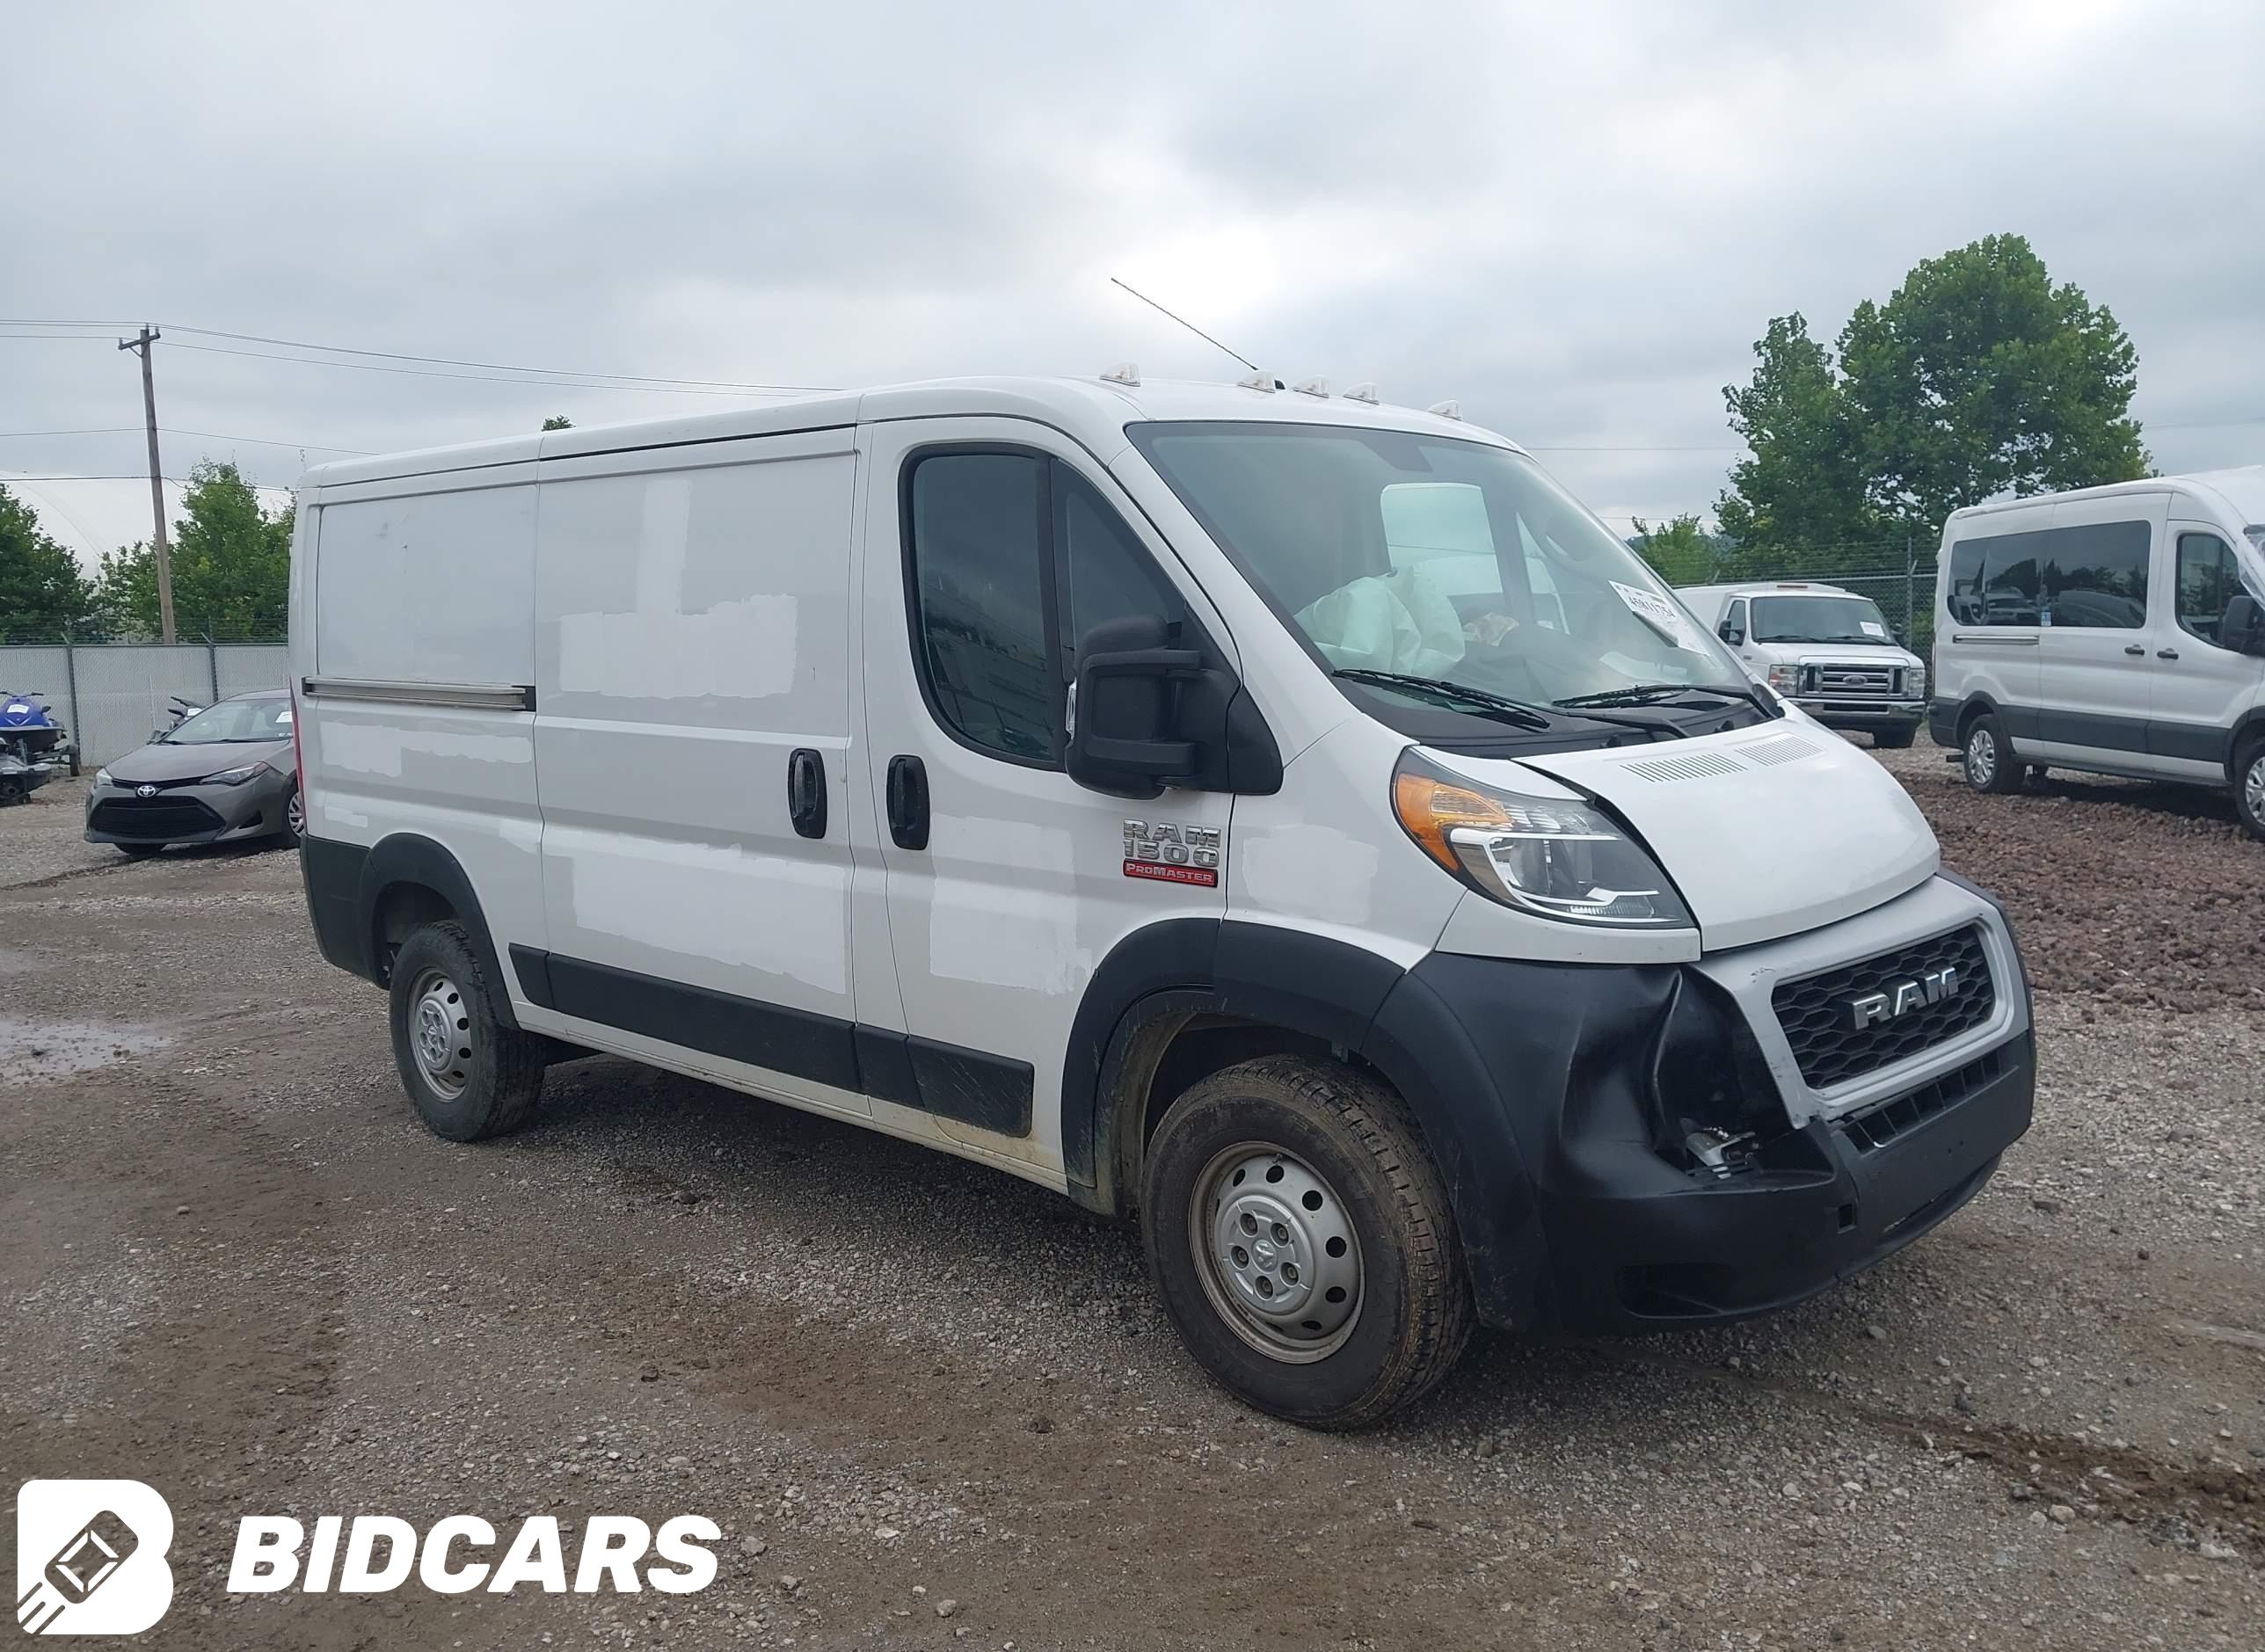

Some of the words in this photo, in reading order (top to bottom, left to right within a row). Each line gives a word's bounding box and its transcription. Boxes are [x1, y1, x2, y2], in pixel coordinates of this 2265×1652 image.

[1123, 819, 1221, 848] RAM
[1123, 838, 1220, 868] 1500
[1853, 967, 1959, 1030] RAM
